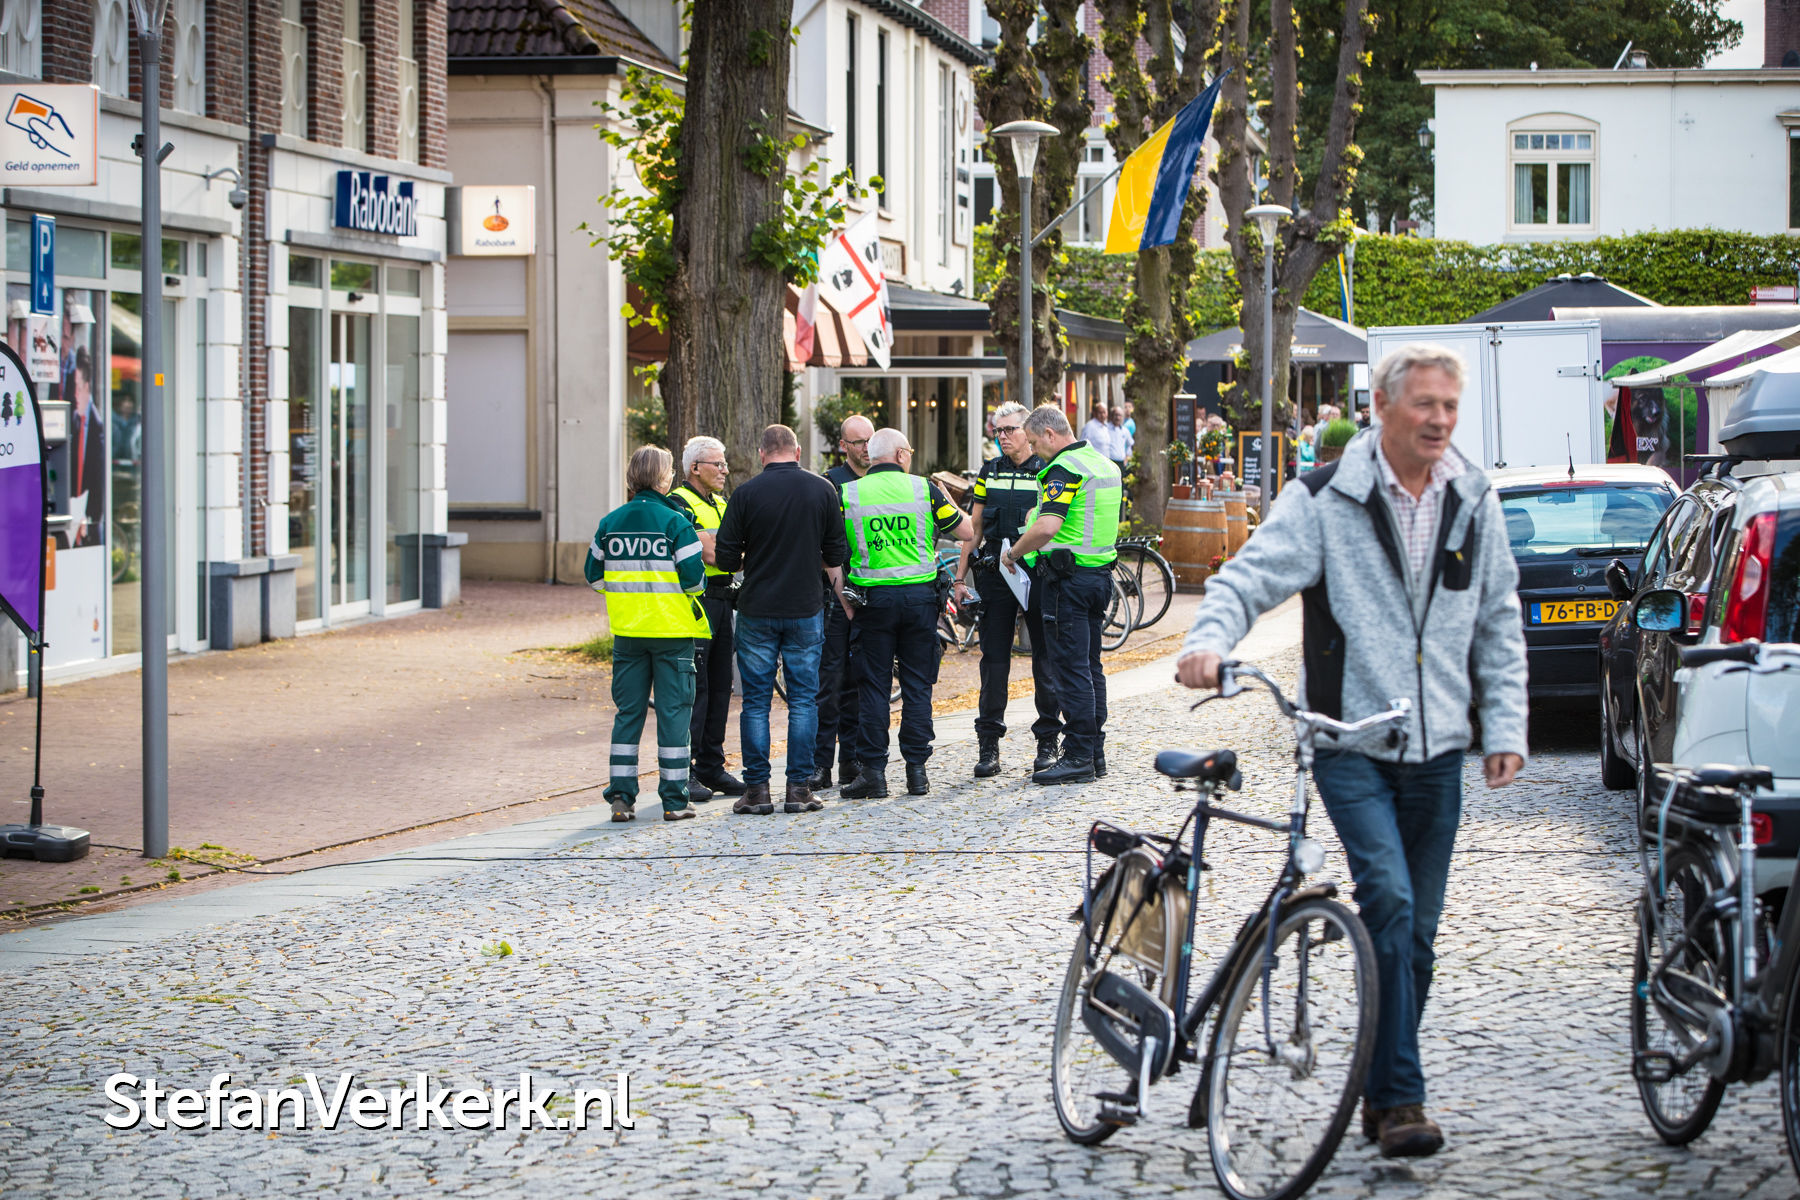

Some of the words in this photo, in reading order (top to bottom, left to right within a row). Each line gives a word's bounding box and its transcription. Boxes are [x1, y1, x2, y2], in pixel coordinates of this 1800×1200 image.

[5, 161, 29, 171] Geld
[31, 163, 80, 173] opnemen
[350, 171, 419, 236] Rabobank
[40, 224, 51, 272] P
[869, 516, 910, 532] OVD
[608, 537, 668, 556] OVDG
